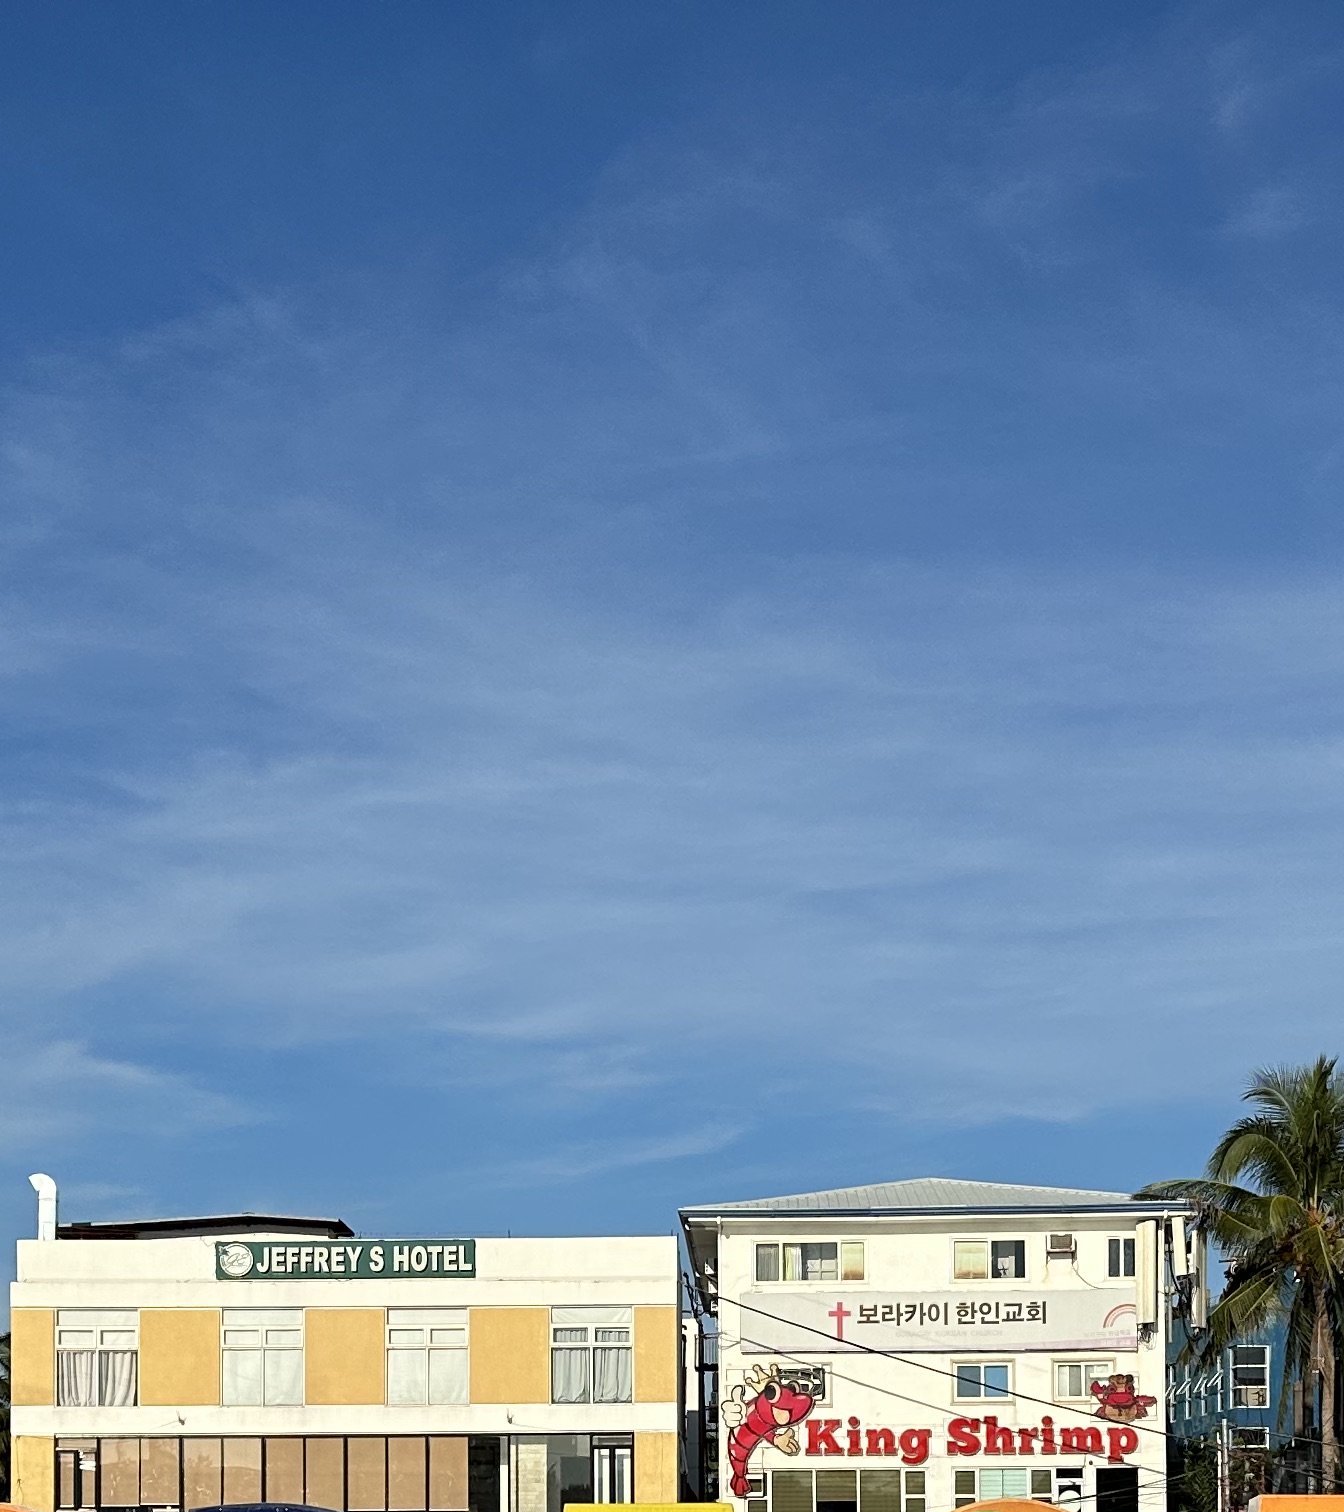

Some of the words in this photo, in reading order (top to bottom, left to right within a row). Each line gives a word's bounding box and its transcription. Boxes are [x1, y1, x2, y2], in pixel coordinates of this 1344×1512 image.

[256, 1246, 364, 1273] JEFFREY
[393, 1244, 474, 1273] HOTEL
[856, 1301, 949, 1326] 보라카이
[955, 1300, 1047, 1325] 한인교회
[805, 1416, 932, 1466] King
[946, 1415, 1140, 1464] Shrimp
